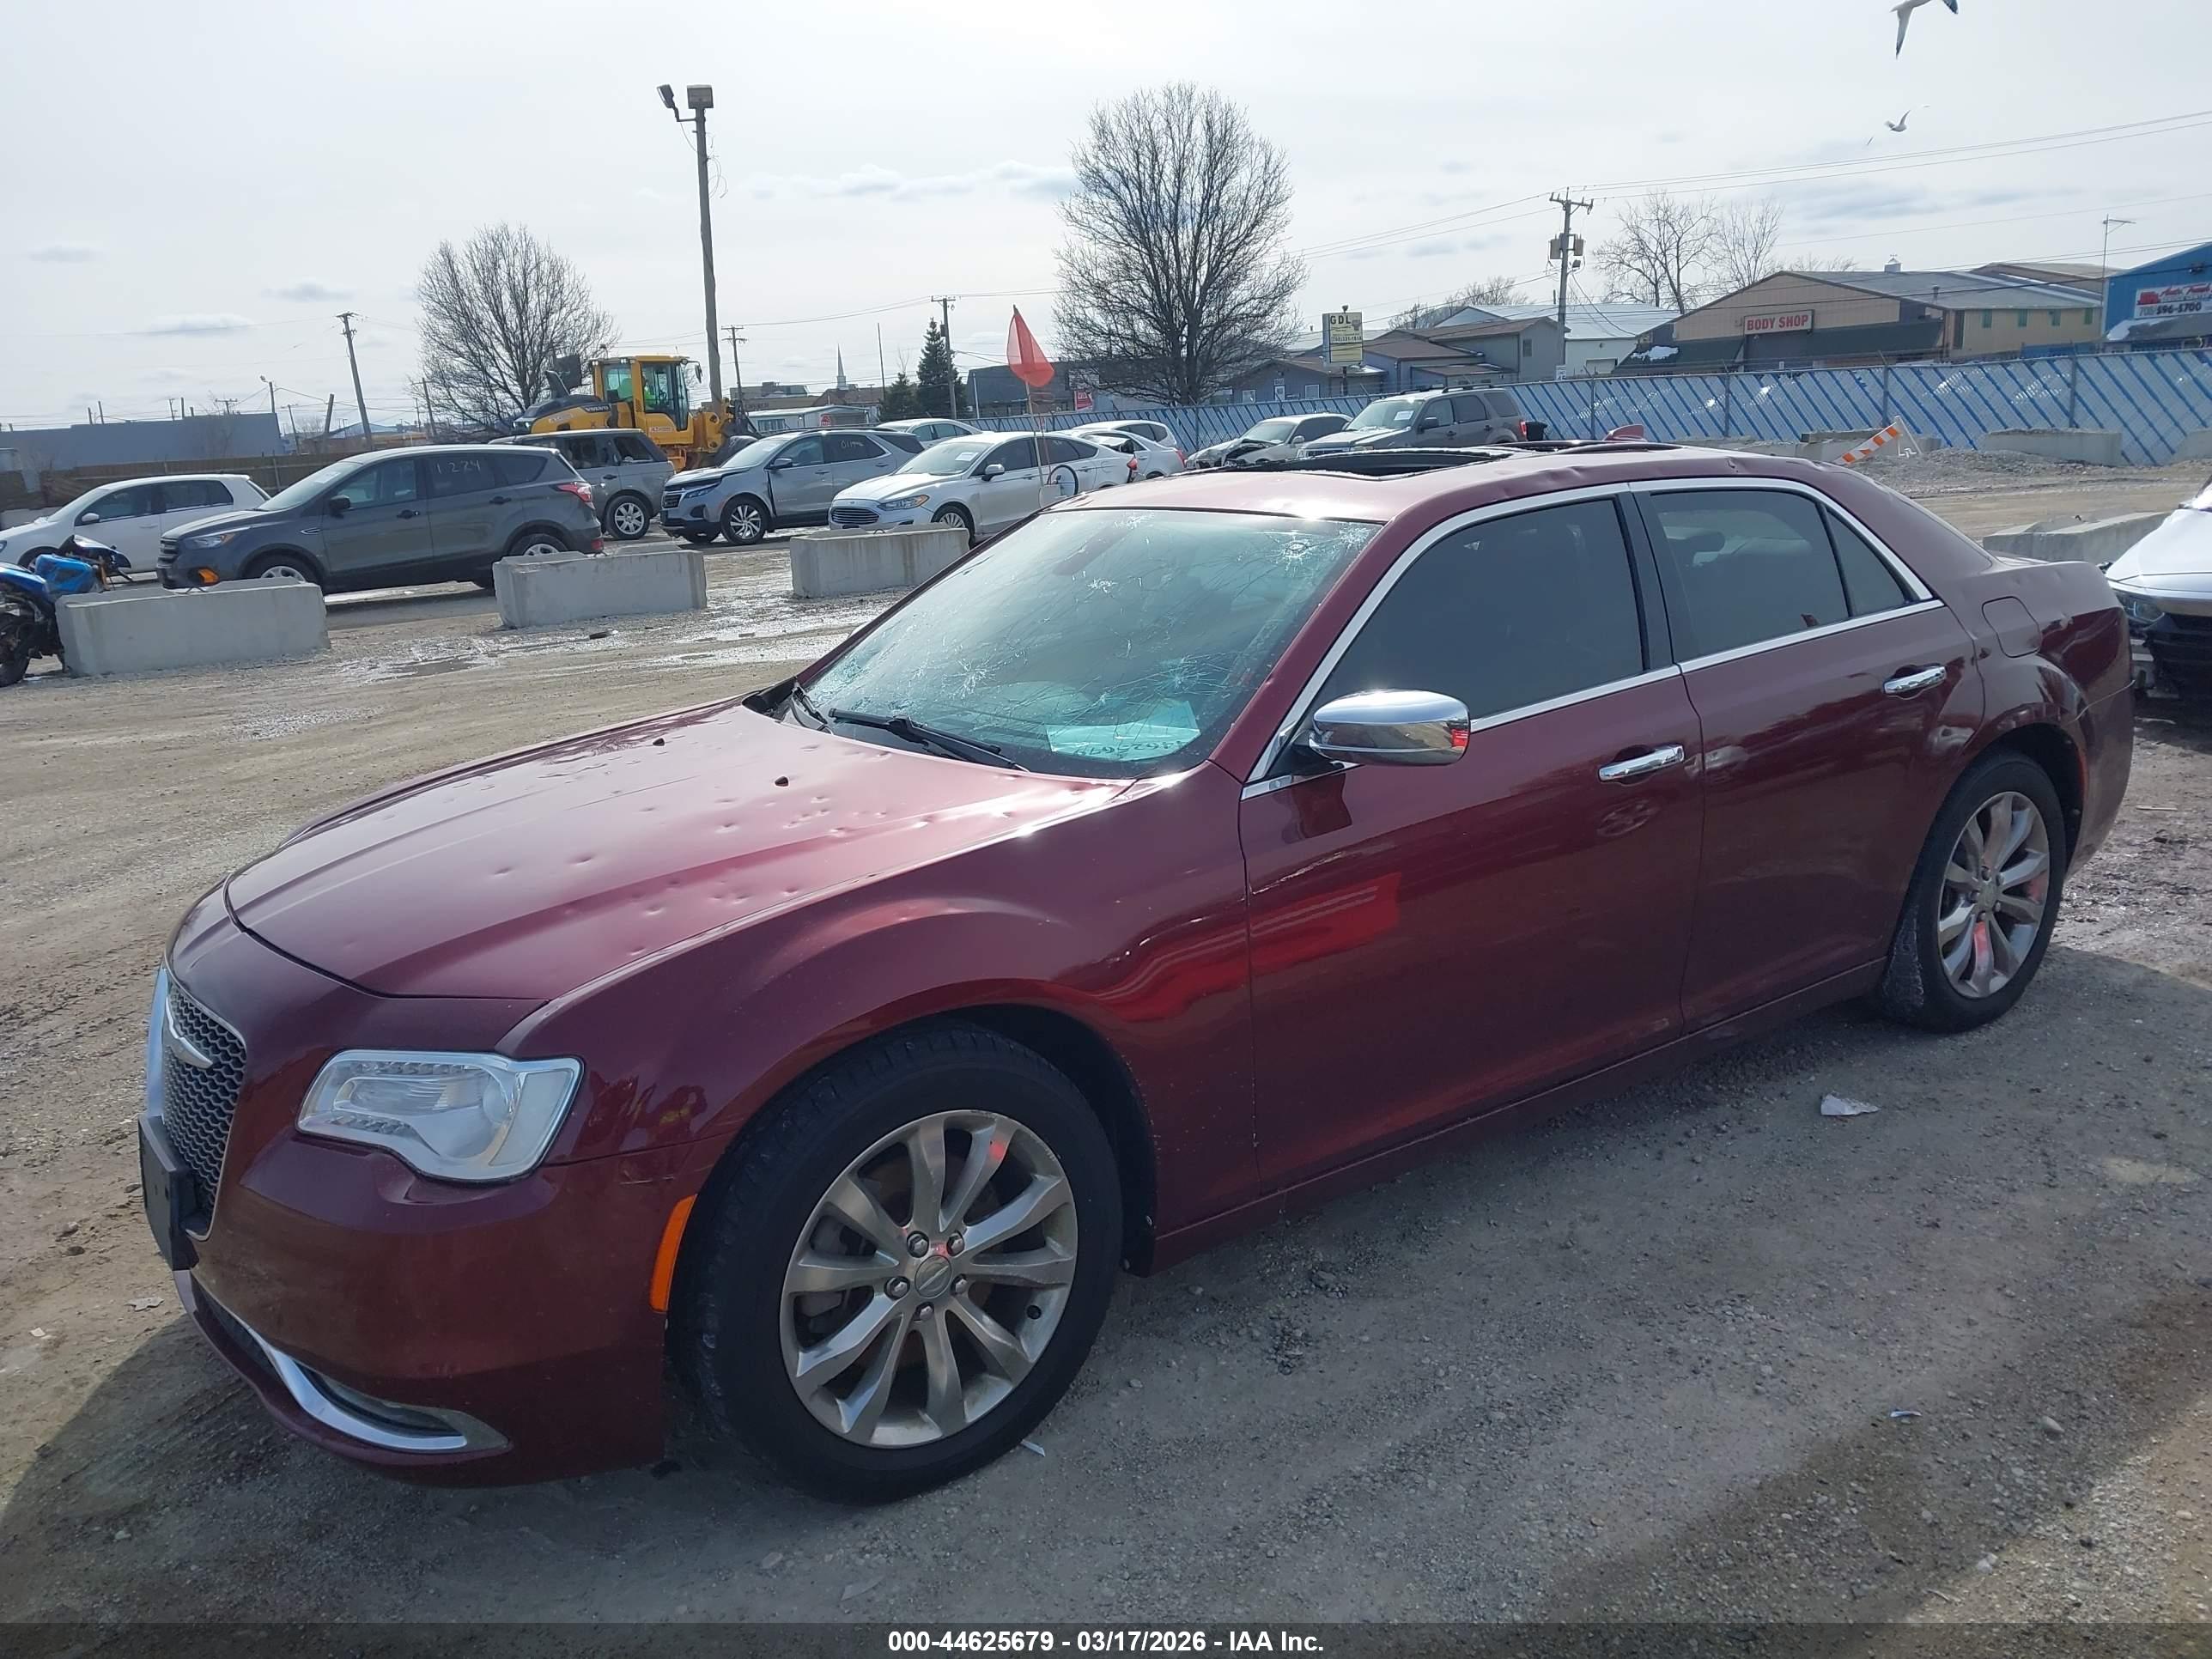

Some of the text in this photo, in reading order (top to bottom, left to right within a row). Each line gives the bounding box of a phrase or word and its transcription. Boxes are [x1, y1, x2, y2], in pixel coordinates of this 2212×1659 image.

[1330, 314, 1352, 325] GDL
[1747, 314, 1808, 331] BODY SHOP
